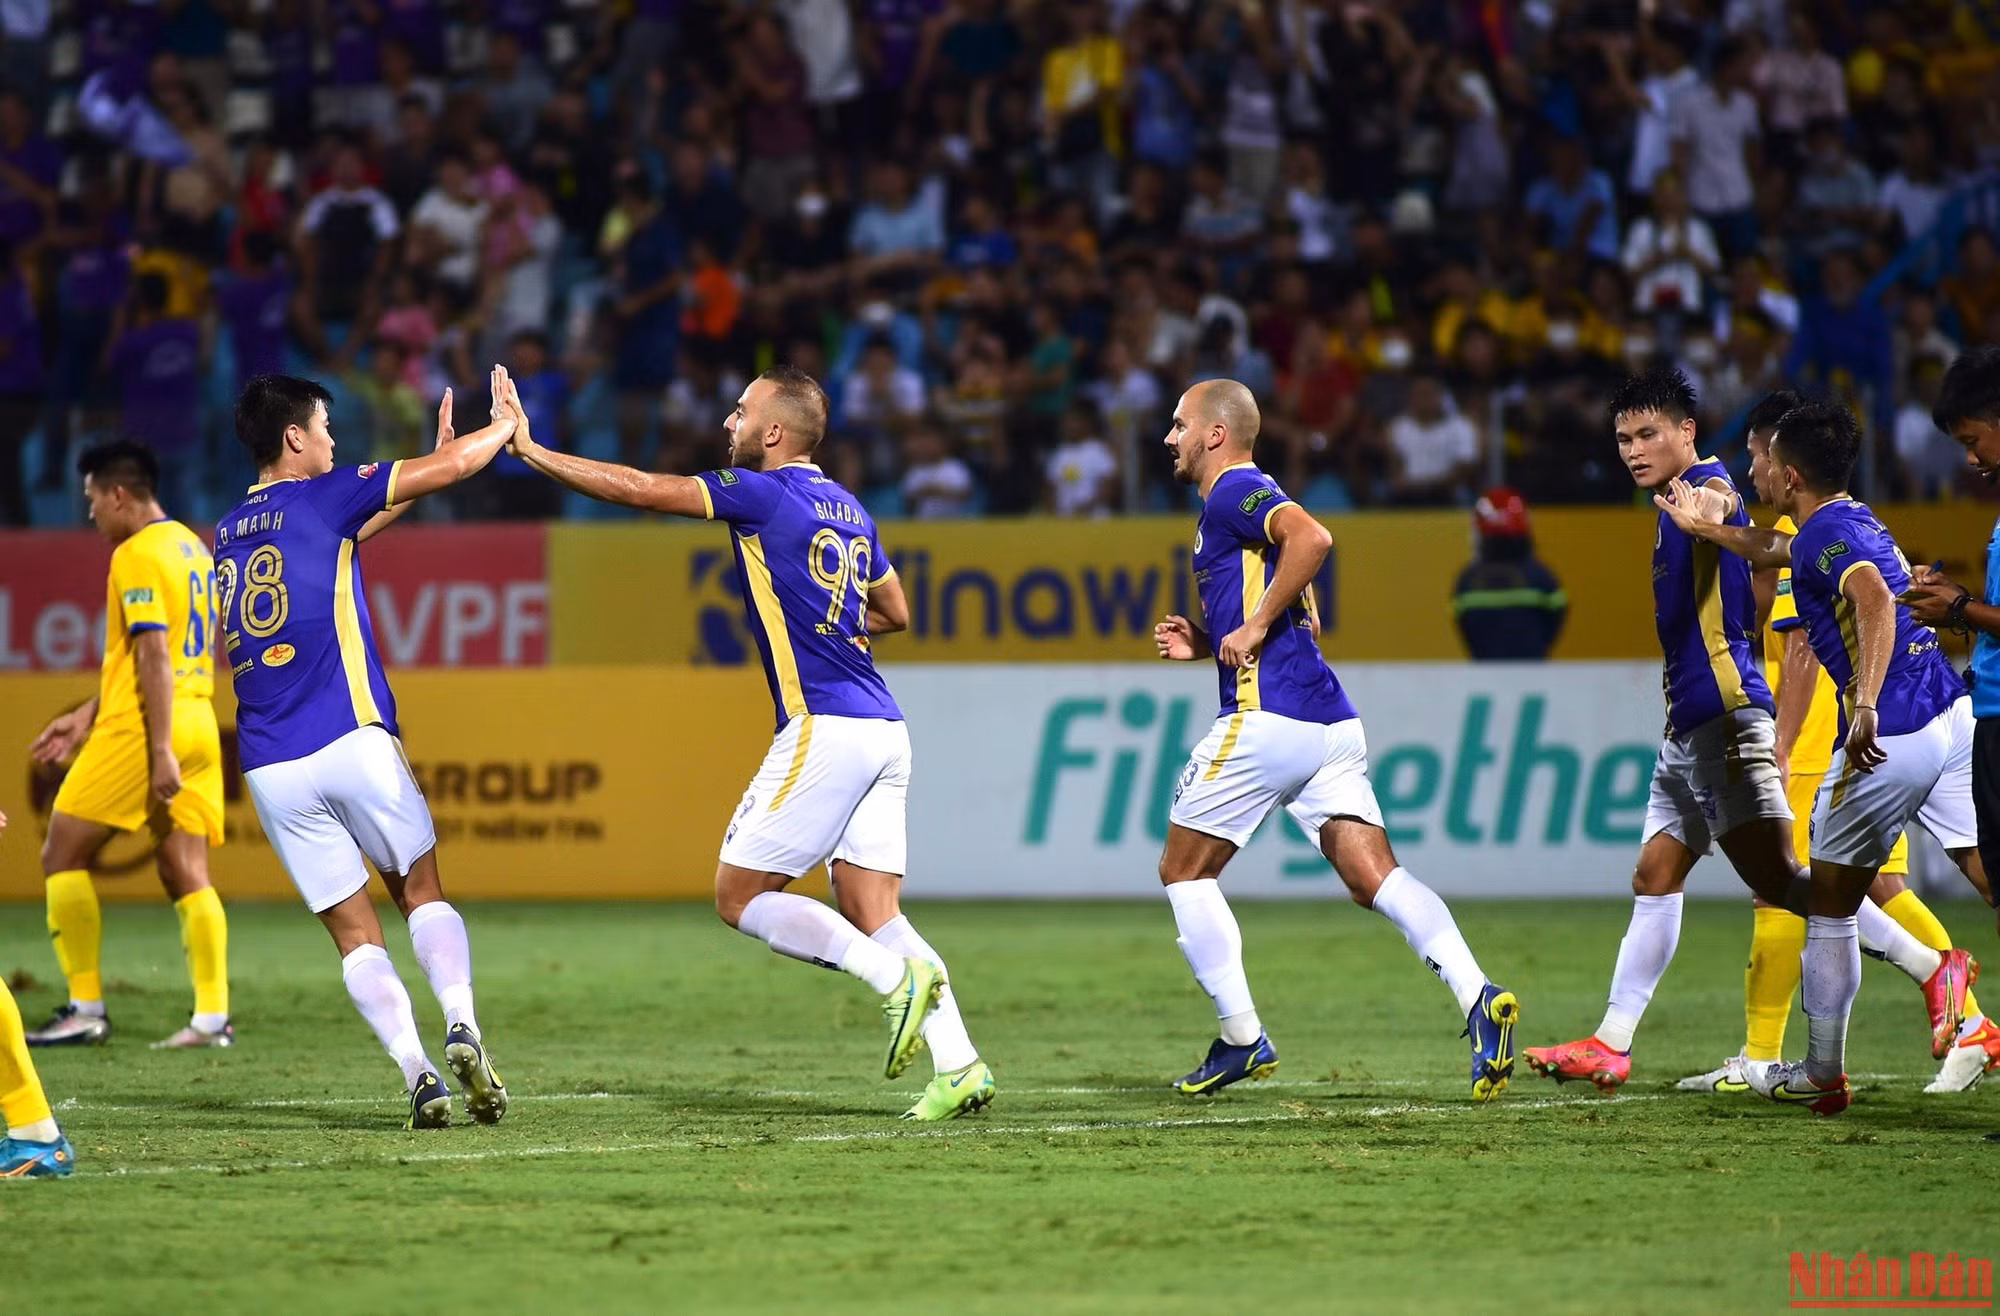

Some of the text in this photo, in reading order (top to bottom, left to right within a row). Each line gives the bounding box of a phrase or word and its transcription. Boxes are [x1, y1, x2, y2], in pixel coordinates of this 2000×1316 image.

[814, 501, 865, 528] SILADJI
[218, 544, 289, 654] 28
[373, 582, 553, 669] VPF
[808, 528, 873, 630] 99
